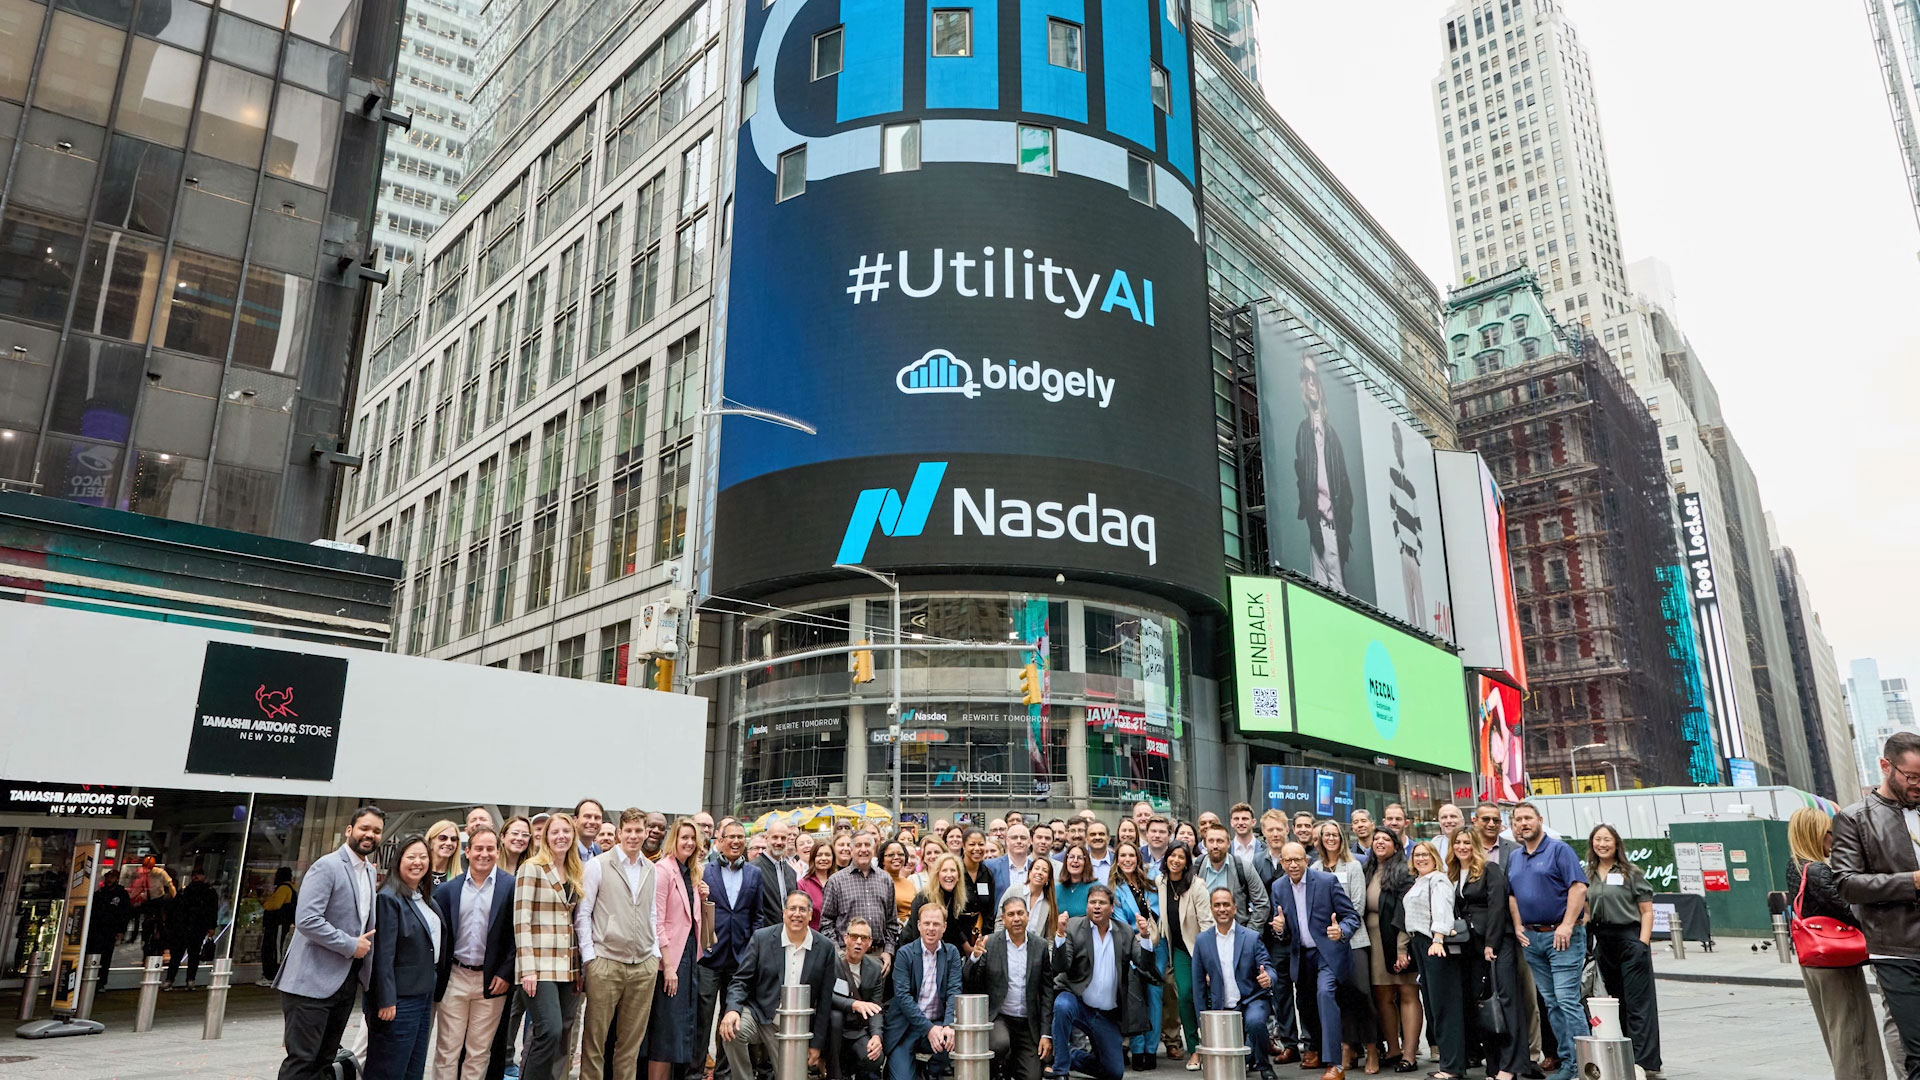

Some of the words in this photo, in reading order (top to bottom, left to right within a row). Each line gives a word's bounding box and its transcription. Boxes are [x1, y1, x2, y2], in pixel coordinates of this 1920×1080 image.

[846, 246, 1155, 327] #UtilityAI
[982, 357, 1116, 408] bidgely
[953, 487, 1157, 566] Nasdaq
[1692, 559, 1715, 599] Foot
[1247, 592, 1269, 677] FINBACK
[1369, 678, 1395, 701] MEZCAL
[202, 715, 251, 730] TAMASHII
[299, 723, 333, 738] STORE
[753, 724, 768, 735] Nasdaq
[775, 721, 799, 731] REWRITE
[801, 718, 840, 728] TOMORROW
[914, 711, 948, 722] Nasdaq
[962, 713, 1000, 722] REWRITE
[1003, 714, 1050, 723] TOMORROW
[240, 732, 263, 741] NEW
[267, 734, 296, 743] YORK
[792, 777, 818, 788] Nasdaq
[957, 771, 1001, 785] Nasdaq
[9, 789, 64, 803] TAMASHII
[63, 793, 115, 805] NATIONS
[116, 794, 154, 808] STORE
[1268, 791, 1284, 799] arm
[50, 805, 77, 814] NEW
[81, 806, 113, 815] YORK
